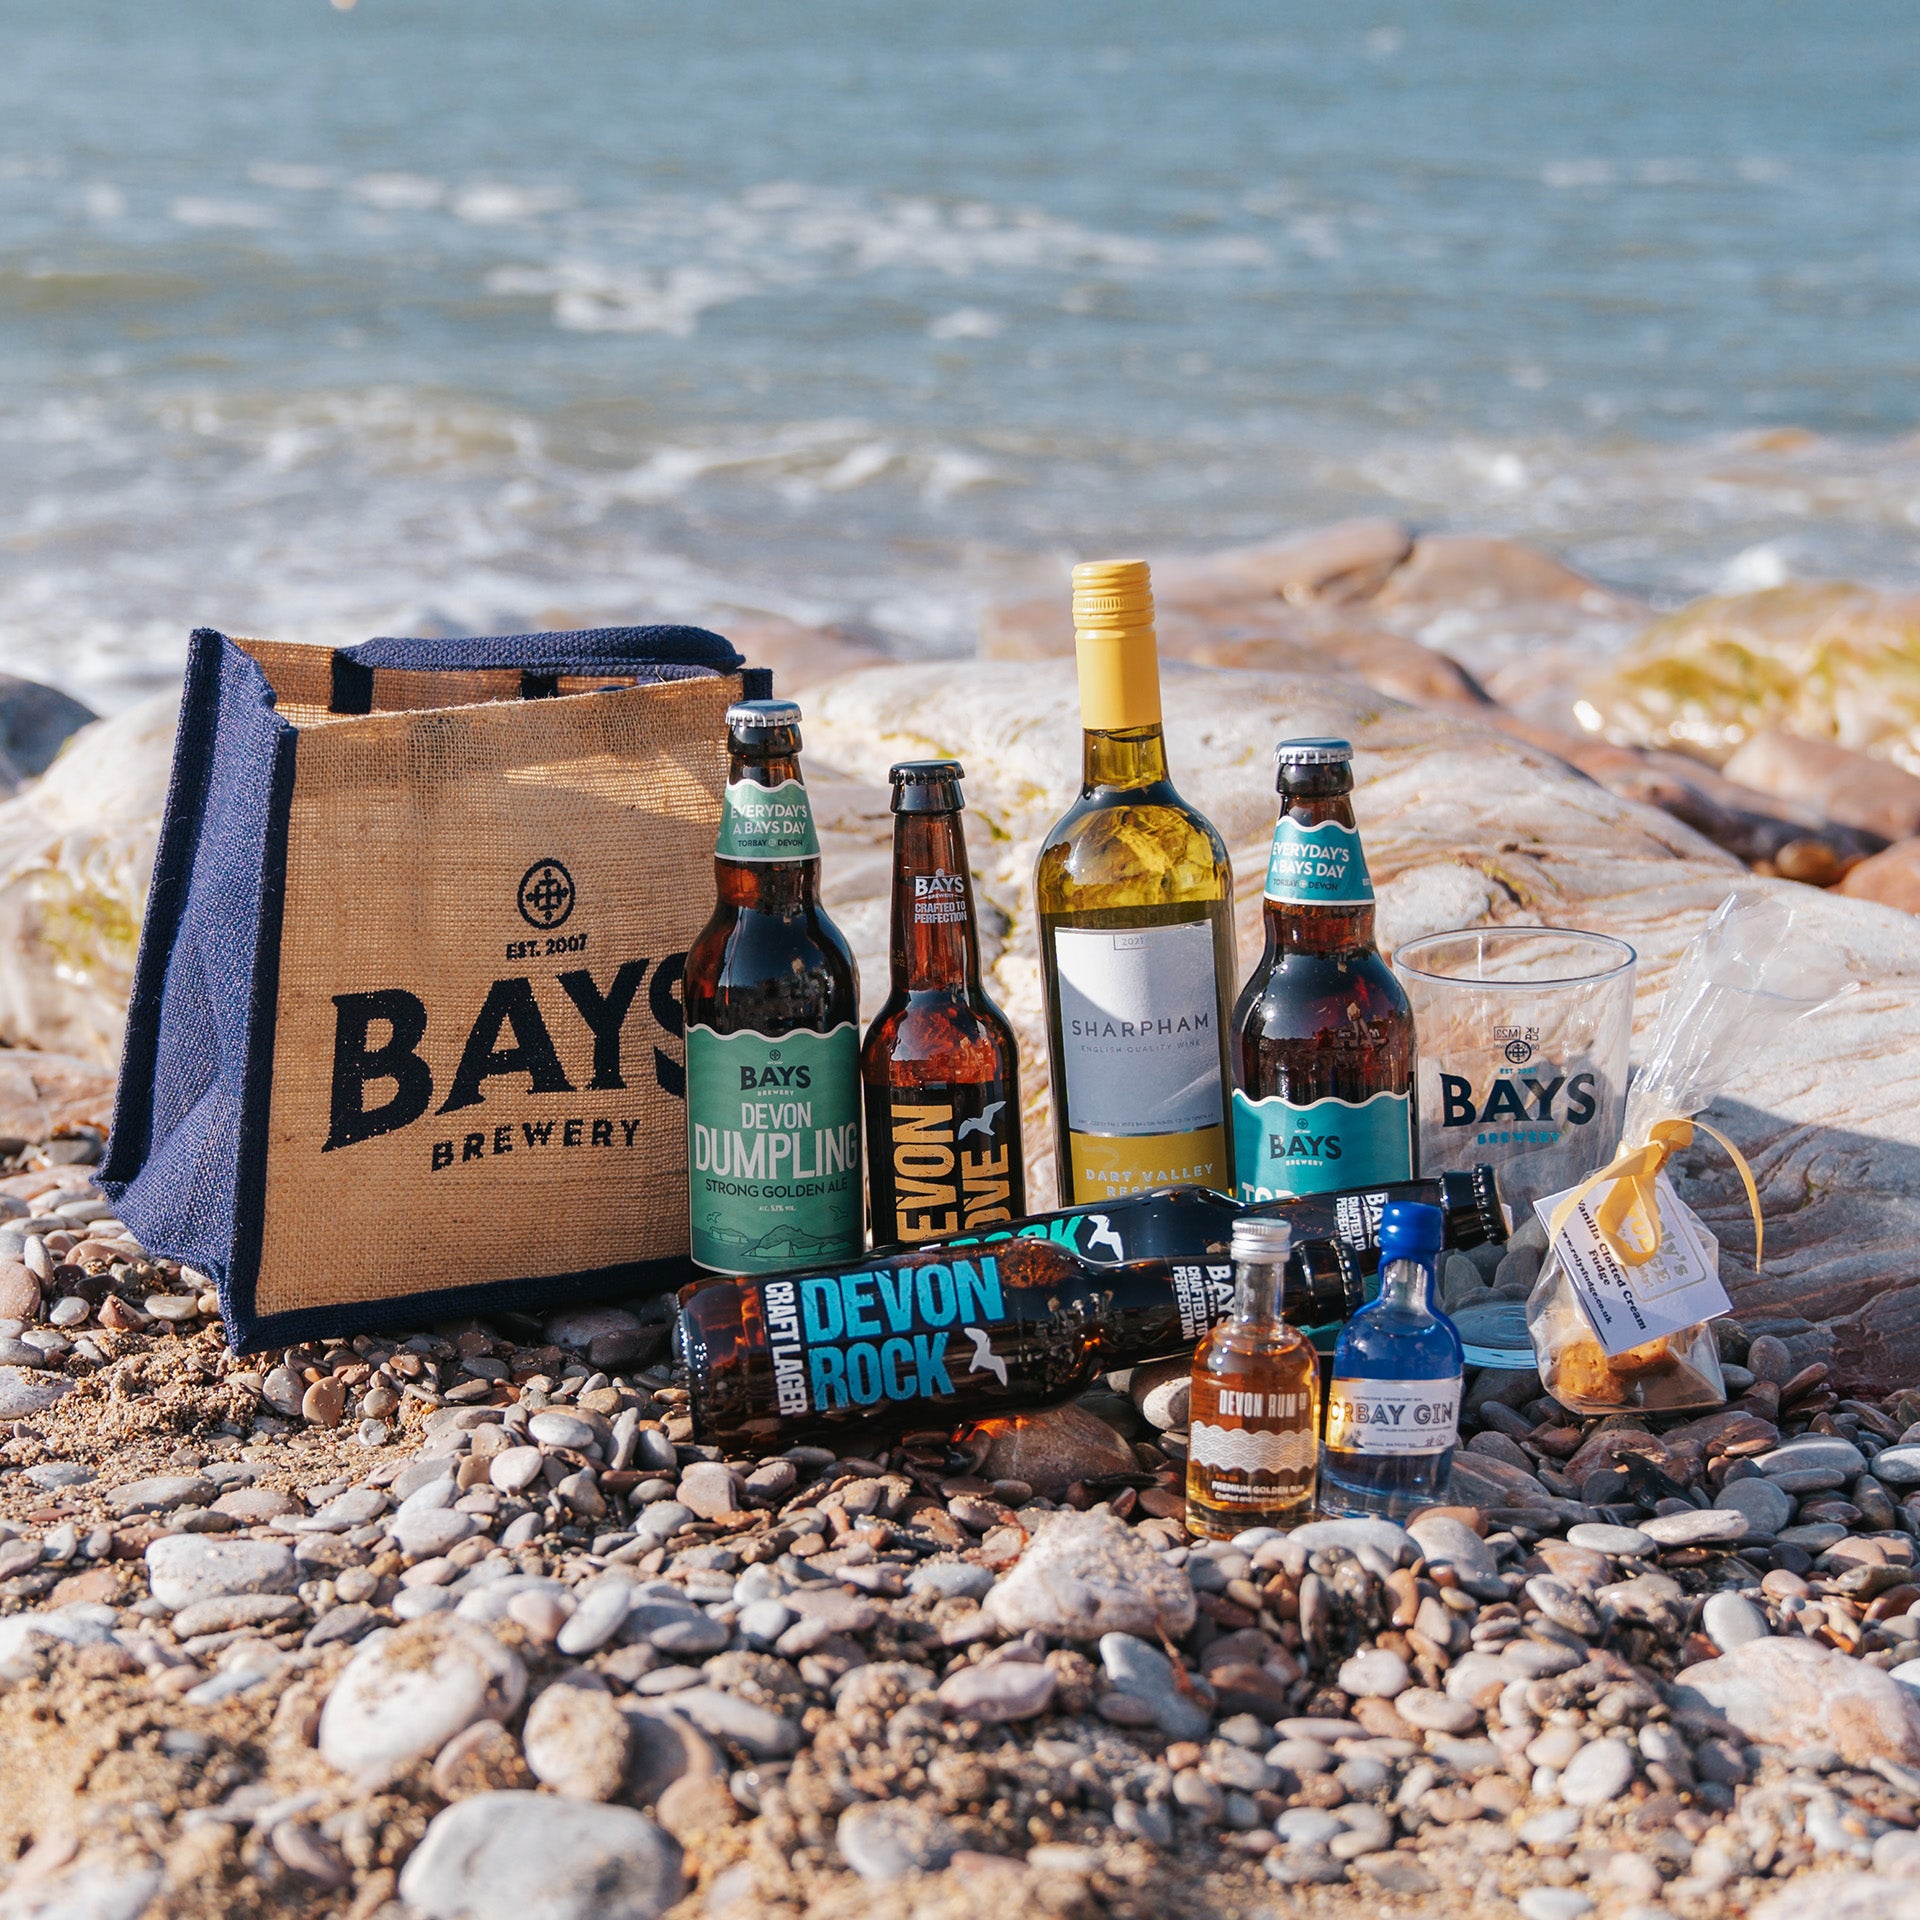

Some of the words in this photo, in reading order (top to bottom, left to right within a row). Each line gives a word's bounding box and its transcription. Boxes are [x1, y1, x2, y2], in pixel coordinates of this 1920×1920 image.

[730, 804, 808, 819] EVERYDAY'S
[733, 823, 742, 835] A
[744, 821, 780, 835] BAYS
[783, 821, 806, 835] DAY
[738, 840, 767, 848] TORBAY
[777, 839, 803, 847] DEVON
[1272, 842, 1350, 862] EVERYDAY'S
[1271, 860, 1278, 874] A
[1279, 860, 1313, 875] BAYS
[1316, 863, 1347, 879] DAY
[915, 877, 964, 897] BAYS
[1309, 881, 1338, 891] DEVON
[914, 911, 967, 924] PERFECTION
[915, 902, 956, 913] CRAFTED
[957, 900, 966, 911] TO
[506, 940, 541, 960] EST.
[545, 933, 588, 955] 2007
[1122, 937, 1144, 946] 2021
[1072, 1012, 1209, 1038] SHARPHAM
[1081, 1044, 1122, 1054] ENGLISH
[1126, 1043, 1172, 1053] QUALITY
[1177, 1039, 1201, 1049] WINE
[740, 1065, 811, 1091] BAYS
[757, 1089, 794, 1097] BREWERY
[1439, 1072, 1596, 1128] BAYS
[741, 1101, 812, 1130] DEVON
[431, 1118, 641, 1172] BREWERY
[694, 1122, 858, 1180] DUMPLING
[1269, 1134, 1342, 1160] BAYS
[1477, 1131, 1561, 1145] BREWERY
[891, 1104, 958, 1241] EVON
[1086, 1169, 1132, 1183] DART
[1142, 1163, 1213, 1183] VALLEY
[705, 1178, 759, 1198] STRONG
[762, 1182, 825, 1199] GOLDEN
[827, 1177, 848, 1192] ALE
[1337, 1197, 1352, 1244] PERFECTI
[1588, 1248, 1611, 1286] Fudge
[800, 1256, 1005, 1343] DEVON
[1187, 1266, 1207, 1320] CRAFTED
[1598, 1243, 1626, 1288] Clotted
[1622, 1290, 1647, 1331] Cream
[764, 1281, 799, 1341] CRAFT
[1172, 1266, 1196, 1340] PERFECTION
[1195, 1320, 1209, 1336] TO
[772, 1345, 809, 1416] LAGER
[808, 1331, 956, 1412] ROCK
[1218, 1389, 1263, 1418] DEVON
[1268, 1393, 1297, 1419] RUM
[1328, 1400, 1406, 1425] ORBAY
[1414, 1401, 1453, 1425] GIN
[1211, 1481, 1251, 1495] PREMIUM
[1252, 1485, 1289, 1495] GOLDEN
[1290, 1484, 1305, 1494] RUM
